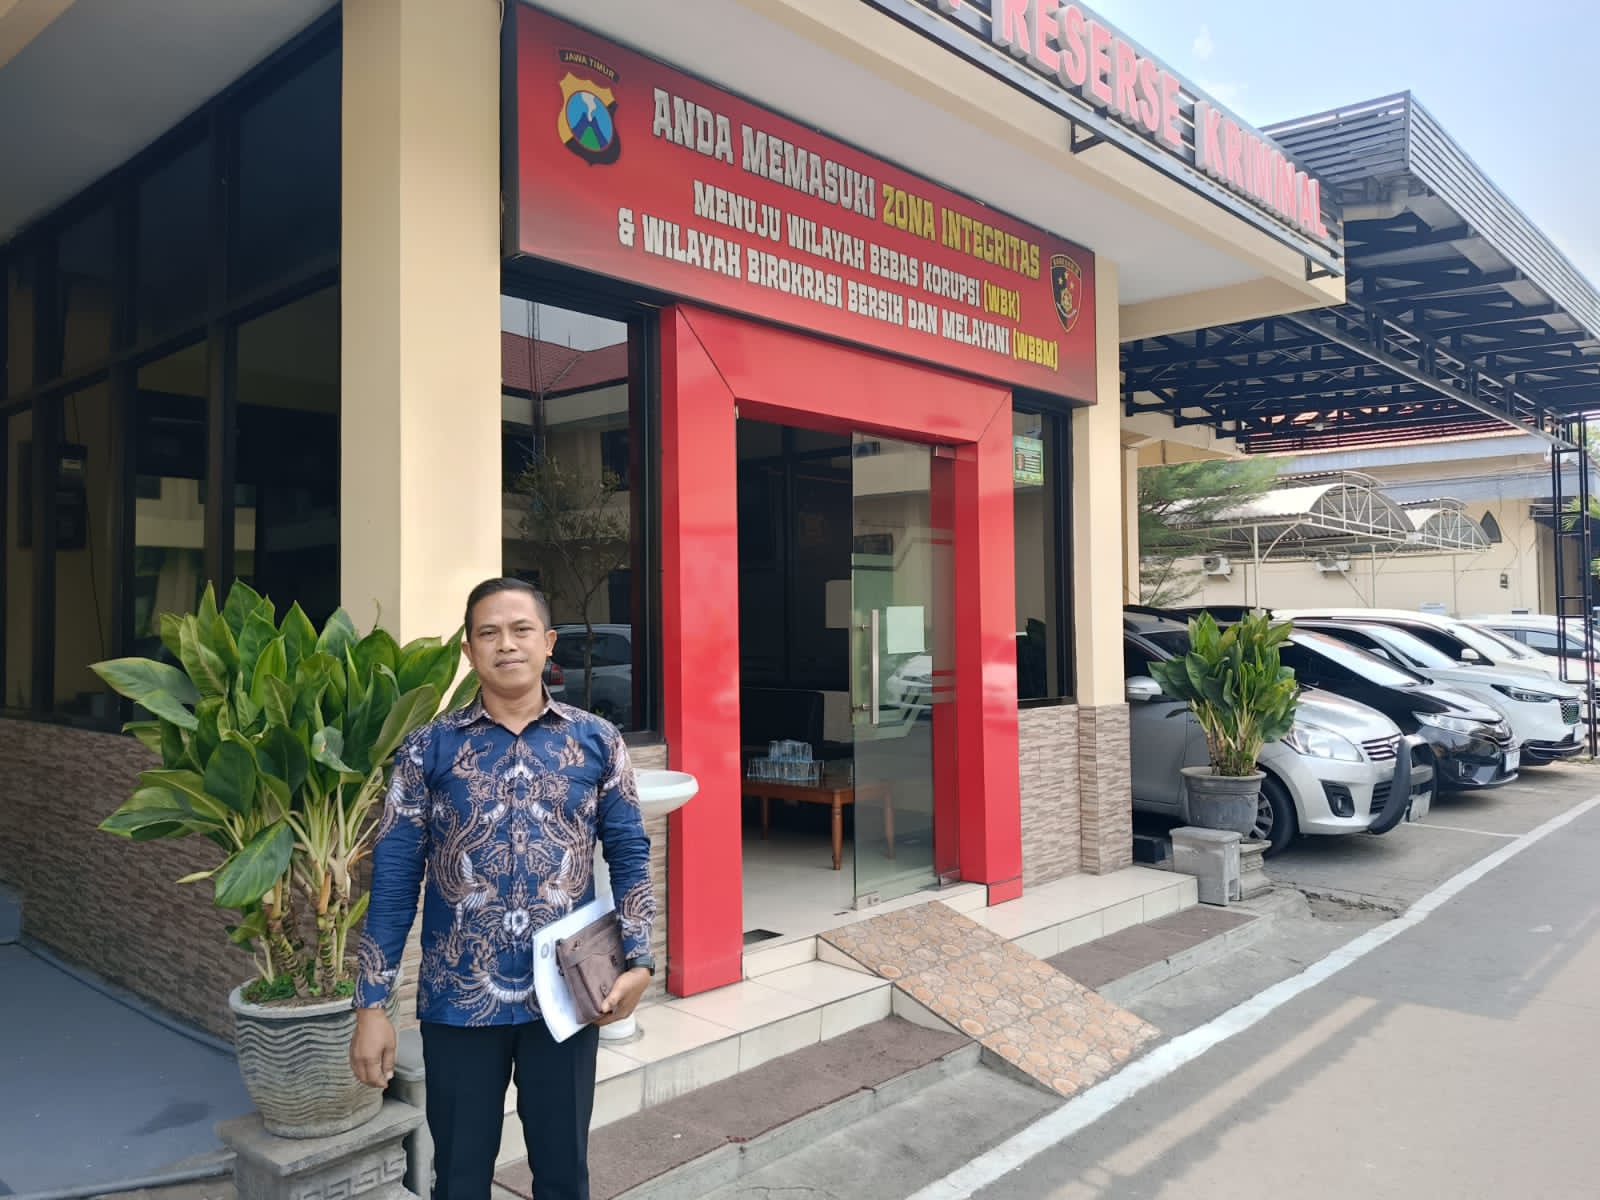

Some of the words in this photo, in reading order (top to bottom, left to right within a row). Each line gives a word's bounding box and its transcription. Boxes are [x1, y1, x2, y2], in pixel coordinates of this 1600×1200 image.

[564, 51, 588, 66] JAWA
[590, 57, 616, 80] TIMUR
[997, 0, 1183, 147] RESERSE
[1198, 101, 1328, 241] KRIMINAL
[653, 87, 734, 165] ANDA
[741, 124, 876, 220] MEMASUKI
[882, 183, 936, 242] ZONA
[941, 207, 1041, 280] INTEGRITAS
[693, 179, 781, 242] MENUJU
[786, 213, 865, 271] WILAYAH
[869, 243, 919, 288] BEBAS
[922, 261, 981, 308] KORUPSI
[983, 279, 1020, 324] (WBK)
[617, 207, 636, 248] &
[641, 213, 741, 280] WILAYAH
[746, 247, 843, 309] BIROKRASI
[847, 279, 904, 326] BERSIH
[907, 298, 939, 336] DAN
[941, 308, 1010, 356] MELAYANI
[1012, 327, 1058, 372] (WBBM)
